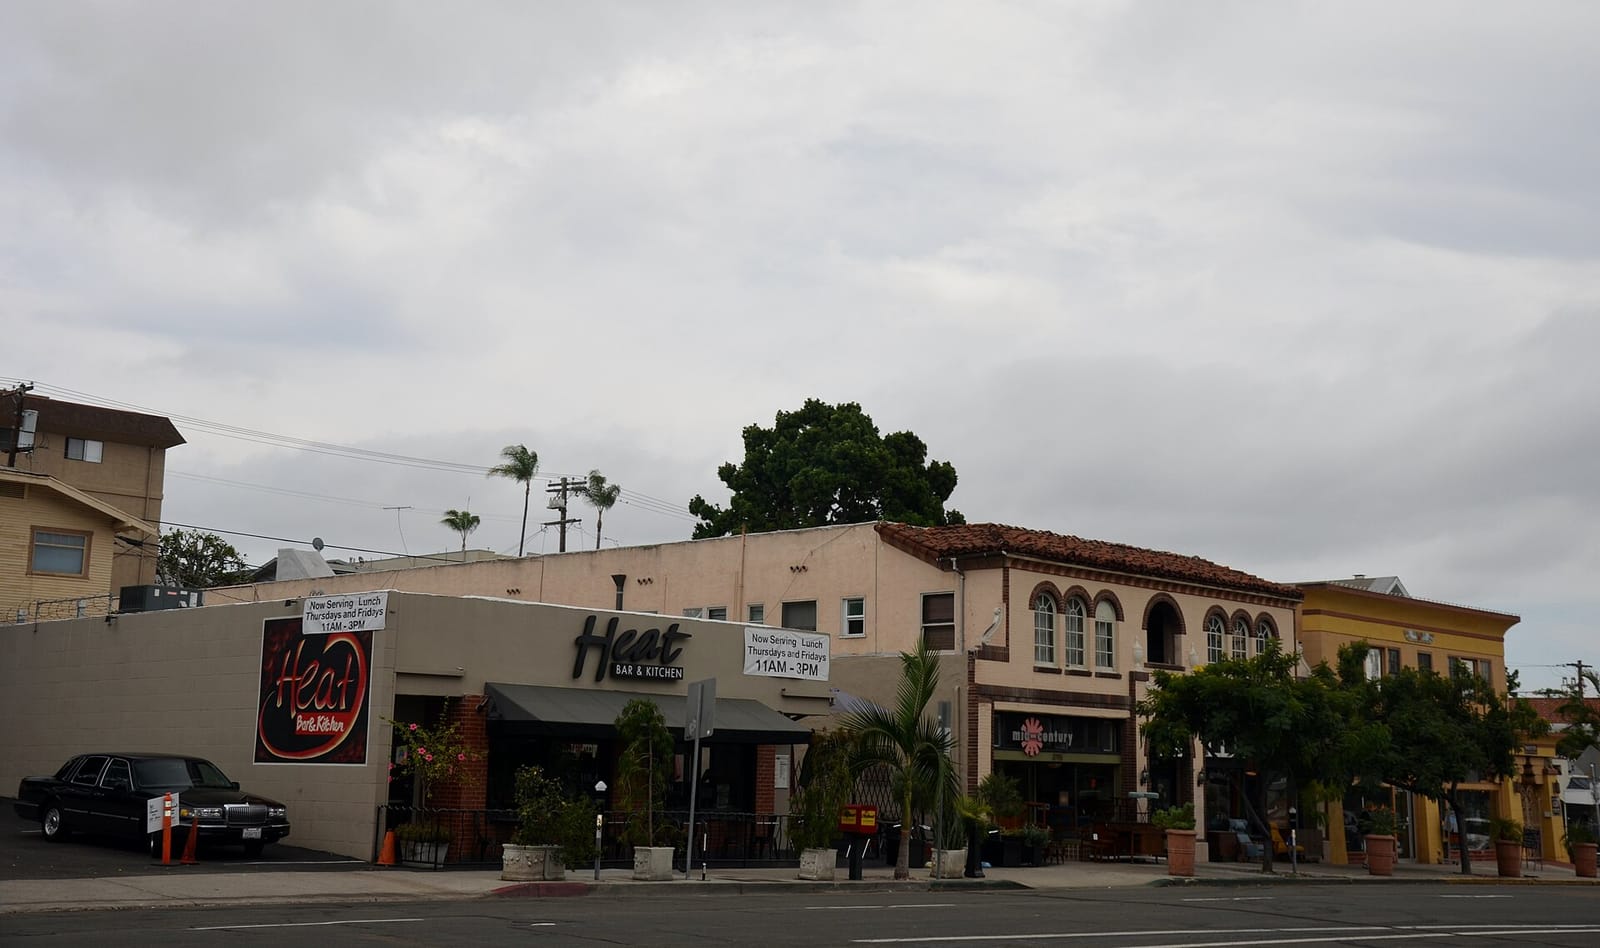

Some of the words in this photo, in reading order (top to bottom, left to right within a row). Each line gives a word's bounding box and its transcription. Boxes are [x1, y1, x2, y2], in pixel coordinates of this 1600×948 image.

[310, 601, 326, 610] Now
[327, 600, 354, 610] Serving
[358, 596, 381, 607] Lunch
[306, 610, 341, 621] Thursdays
[343, 609, 356, 618] and
[358, 608, 384, 618] Fridays
[322, 621, 342, 631] 11AM
[348, 620, 365, 631] 3PM
[573, 615, 692, 681] Heat
[752, 633, 769, 644] Now
[770, 635, 797, 648] Serving
[802, 638, 823, 649] Lunch
[748, 645, 785, 659] Thursdays
[802, 650, 827, 663] Fridays
[616, 664, 633, 676] BAR
[636, 665, 643, 676] &
[646, 666, 682, 679] KITCHEN
[756, 660, 787, 673] 11AM
[797, 662, 818, 676] 3PM
[276, 639, 354, 719] Heat
